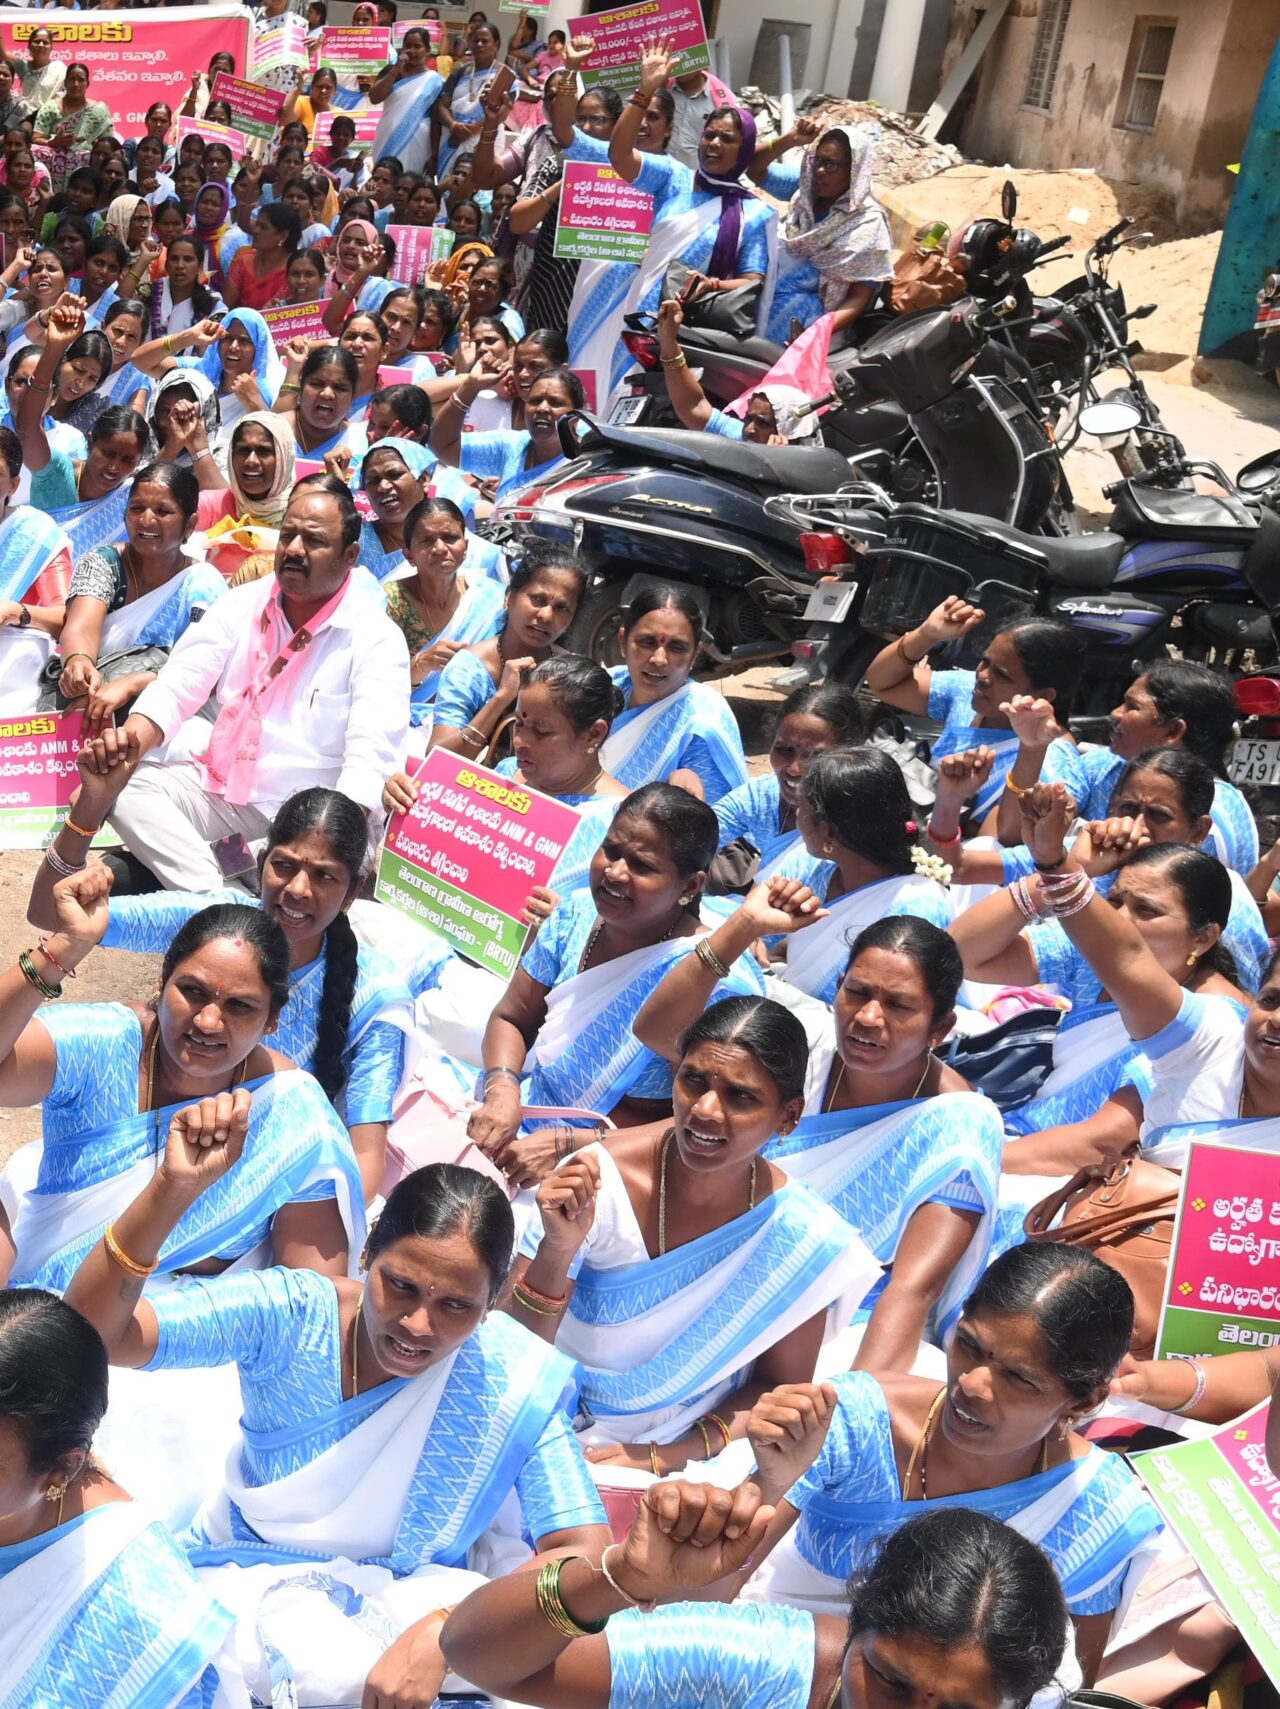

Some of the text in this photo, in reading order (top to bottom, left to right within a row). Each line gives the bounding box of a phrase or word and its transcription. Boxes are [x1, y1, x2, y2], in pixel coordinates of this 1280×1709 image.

[76, 51, 118, 62] జీతాలు
[122, 50, 169, 65] ఇవ్వాలి.
[682, 56, 708, 70] (BRTU)
[92, 70, 186, 86] వేతనం ఇవ్వాలి.
[126, 112, 146, 122] GN
[40, 740, 67, 755] ANM
[72, 740, 80, 750] &
[1246, 743, 1268, 762] TS
[456, 768, 532, 815] ఆశాలకు
[420, 781, 562, 860] అర్హత కలిగిన ఆశాలకు ANM & GNM
[396, 831, 468, 882] పనిభారం తగ్గించాలి
[454, 823, 494, 854] అవకాశం
[493, 843, 536, 878] కల్పించాలి.
[398, 865, 505, 942] తెలంగాణ గ్రామీణ ఆరోగ్య
[380, 879, 416, 912] కార్యకర్తల
[416, 902, 444, 929] (ఆశా)
[444, 920, 476, 946] సంఘం
[483, 940, 515, 972] (BRTU)
[1213, 1196, 1263, 1231] అర్హత
